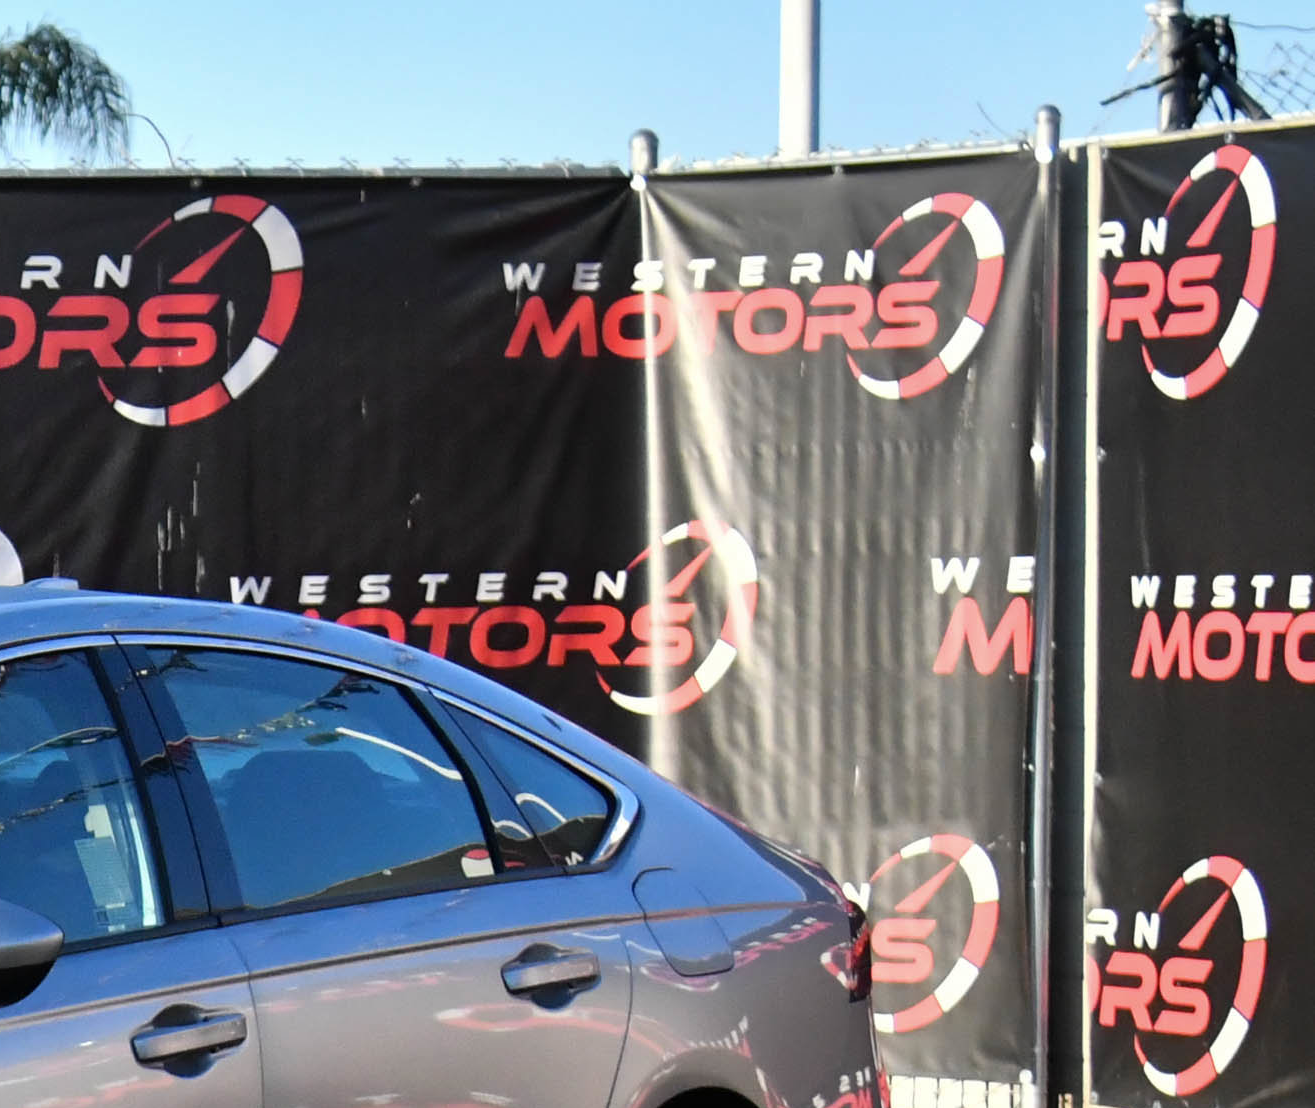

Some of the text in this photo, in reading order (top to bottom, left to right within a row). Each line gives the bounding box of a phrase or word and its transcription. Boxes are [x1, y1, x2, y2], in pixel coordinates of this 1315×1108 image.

[503, 249, 875, 292] WESTERN
[505, 281, 941, 359] MOTORS
[230, 571, 628, 604] WESTERN
